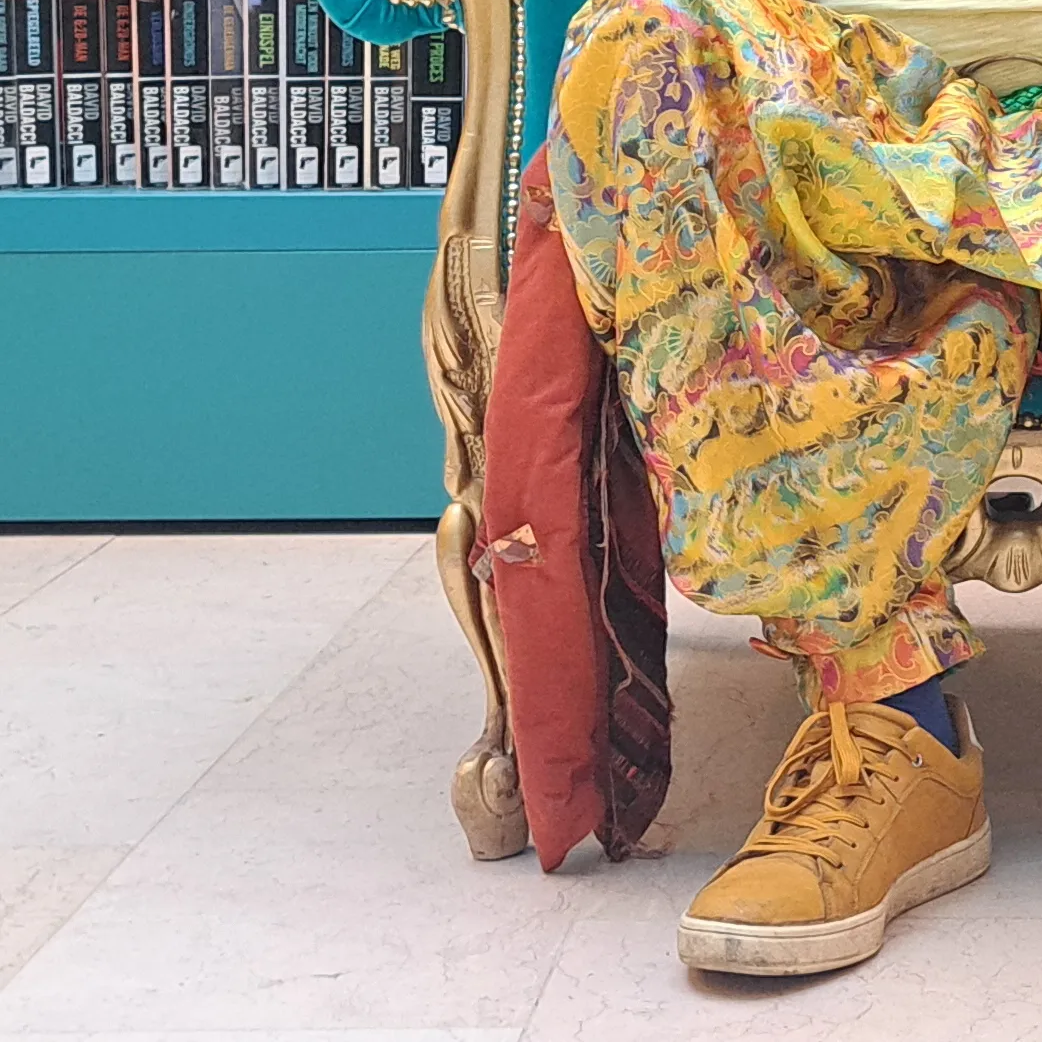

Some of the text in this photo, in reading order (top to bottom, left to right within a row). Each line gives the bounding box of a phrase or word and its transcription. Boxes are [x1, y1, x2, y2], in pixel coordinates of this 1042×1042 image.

[259, 13, 275, 69] EINDSPEL
[19, 83, 37, 146] BALDACCI
[36, 83, 52, 121] DAVID
[66, 83, 84, 145] BALDACCI
[83, 83, 100, 121] DAVID
[109, 83, 127, 144] BALDACCI
[142, 86, 162, 148] BALDACCI
[173, 86, 191, 148] BALDACCI
[190, 85, 207, 123] DAVID
[231, 87, 244, 125] DAVID
[252, 86, 268, 148] BALDACCI
[268, 86, 279, 124] DAVID
[290, 86, 307, 148] BALDACCI
[308, 86, 324, 124] DAVID
[331, 86, 348, 147] BALDACCI
[349, 86, 363, 124] DAVID
[374, 86, 390, 148] BALDACCI
[390, 86, 405, 124] DAVID
[436, 107, 452, 143] DAVID
